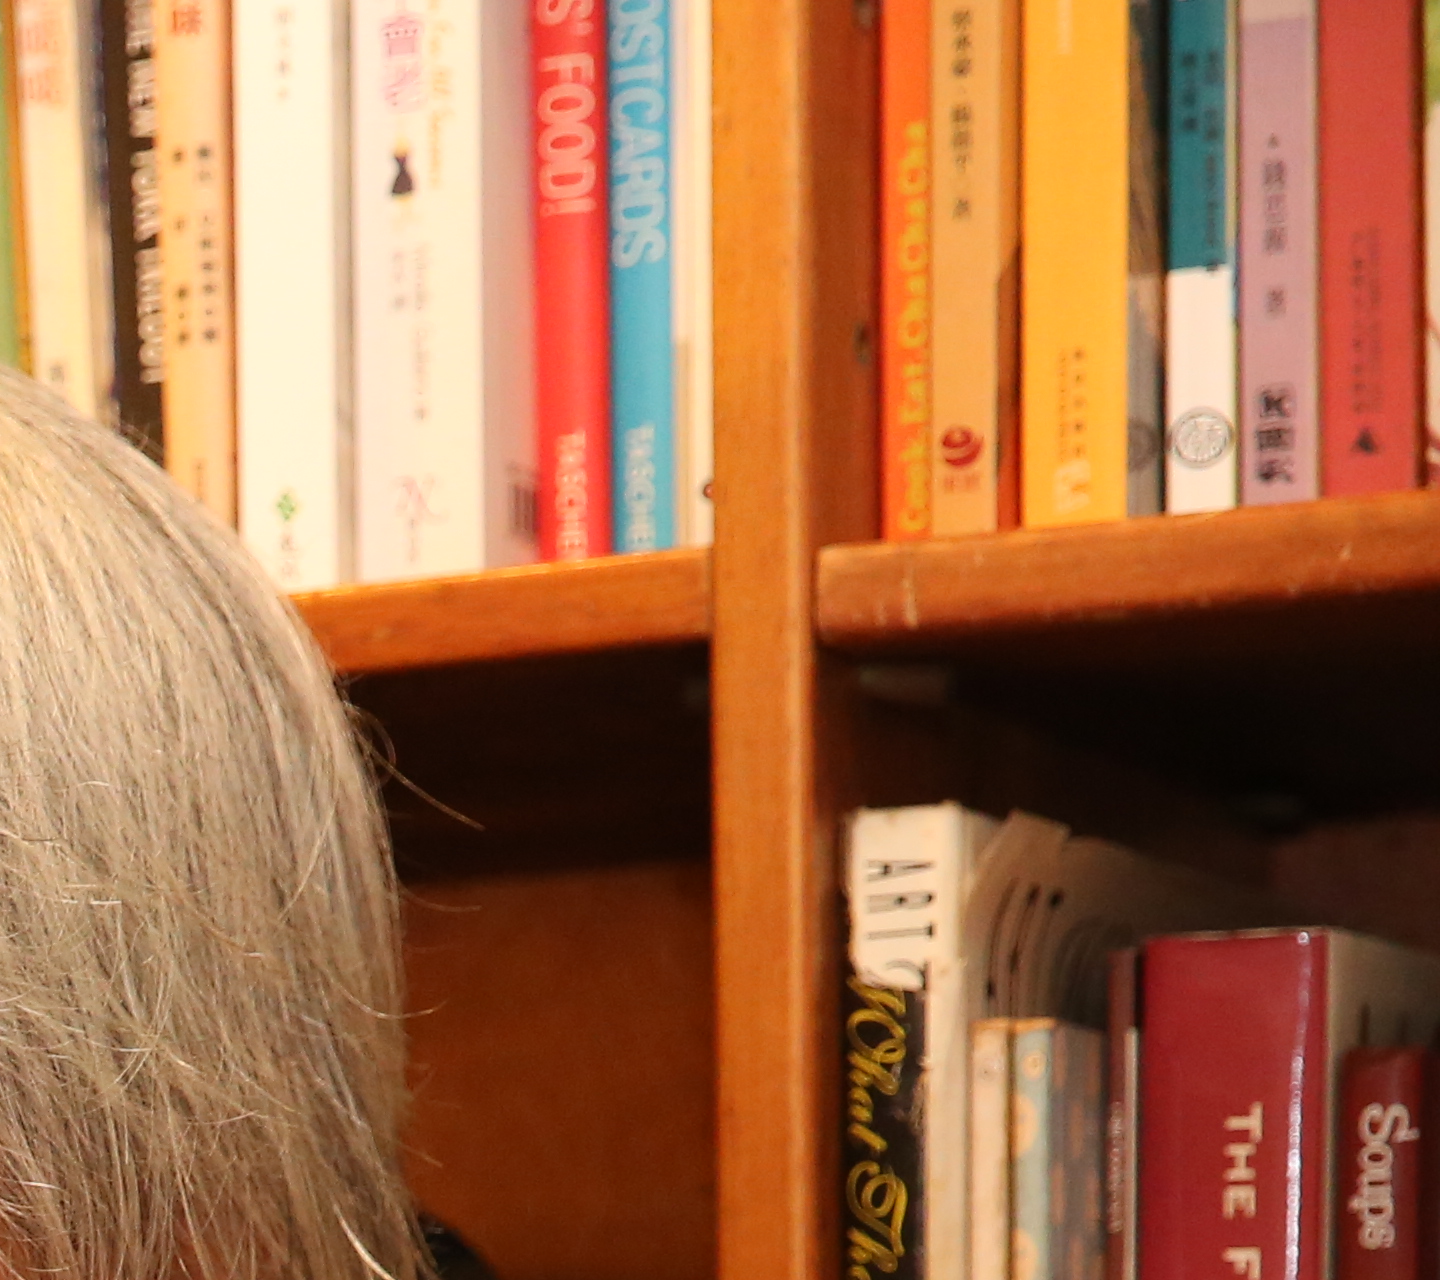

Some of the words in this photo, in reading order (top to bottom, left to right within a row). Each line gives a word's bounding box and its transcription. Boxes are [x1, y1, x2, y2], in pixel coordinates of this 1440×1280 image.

[537, 51, 597, 217] FOOD!
[845, 974, 911, 1154] What
[1222, 1102, 1263, 1219] THE
[1359, 1101, 1419, 1249] Soups
